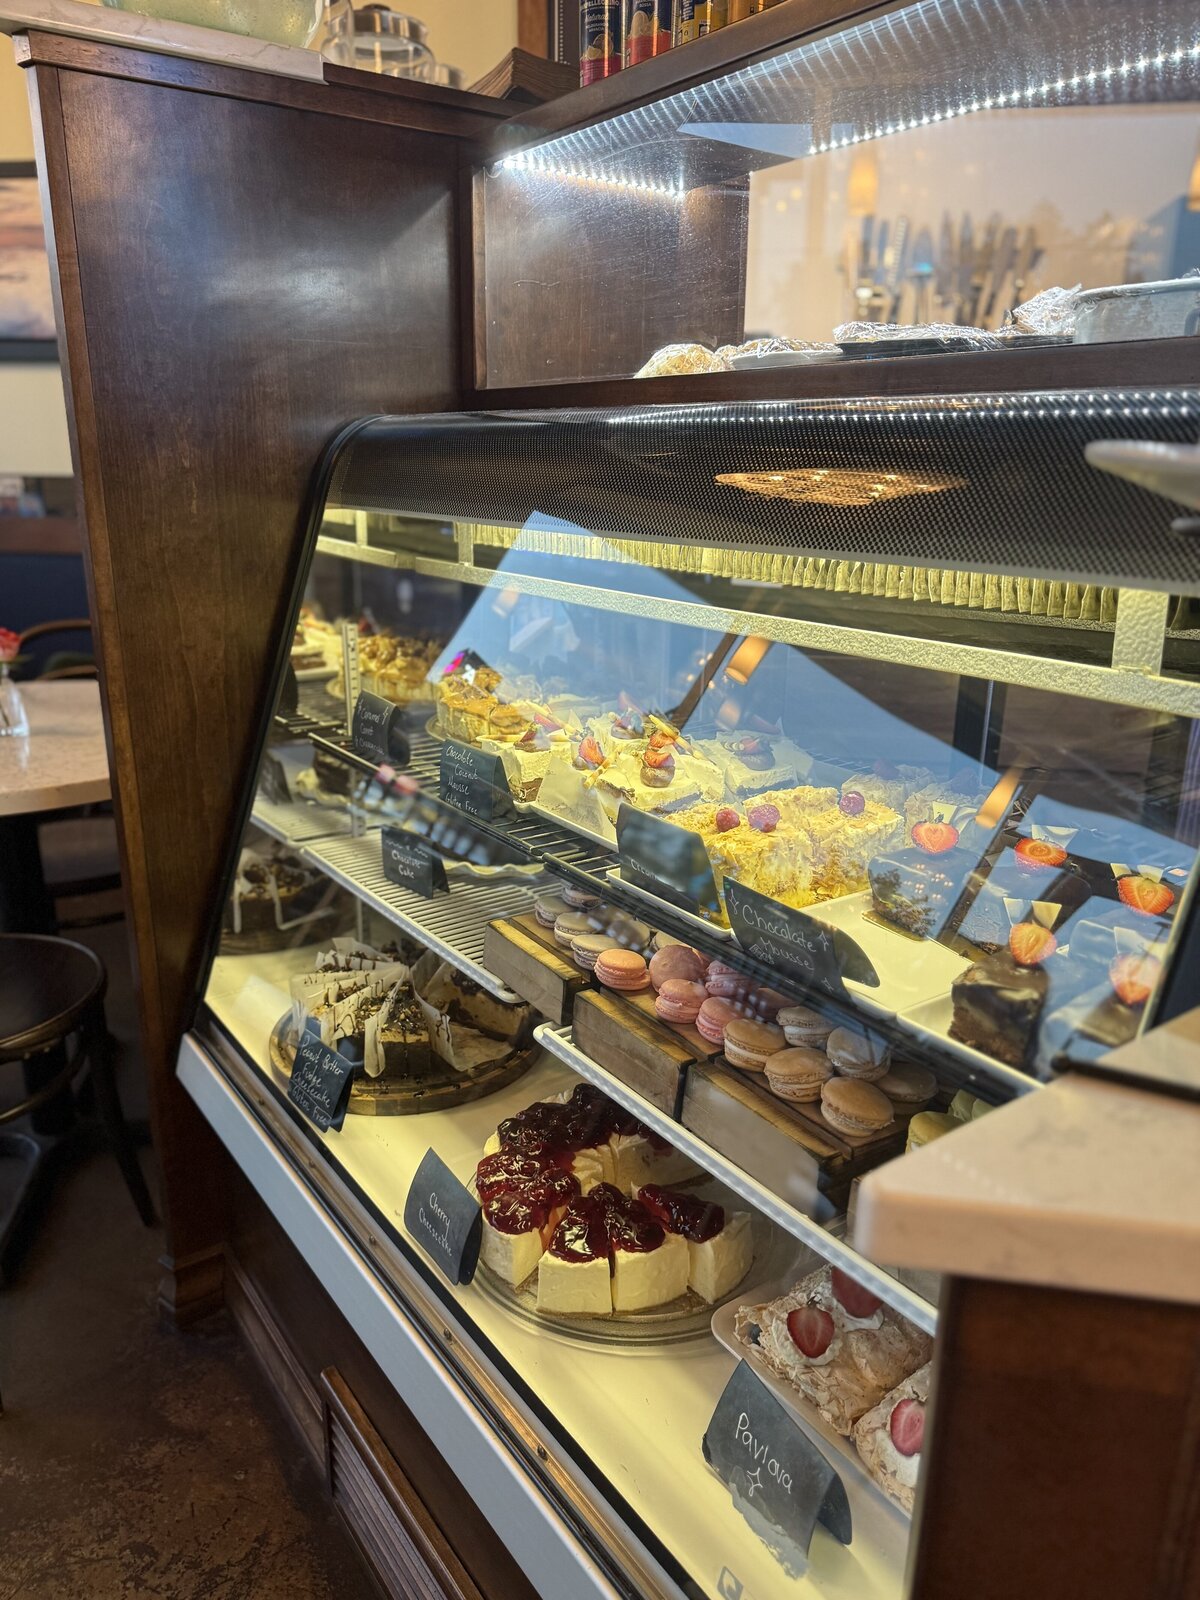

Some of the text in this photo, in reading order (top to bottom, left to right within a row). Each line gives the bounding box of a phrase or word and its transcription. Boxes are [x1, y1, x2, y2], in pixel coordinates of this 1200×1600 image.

[445, 745, 474, 767] Chocolate
[447, 775, 470, 795] Mousse
[445, 792, 478, 815] Gluten Free
[391, 850, 421, 869] Chocolate
[398, 864, 415, 879] Cake
[742, 904, 817, 953] Chocolate
[759, 936, 815, 971] Mousse
[299, 1034, 344, 1076] Peanut Butter
[302, 1062, 322, 1087] Fudge
[293, 1071, 331, 1107] Cheesecake
[312, 1105, 333, 1126] Free
[429, 1192, 451, 1241] Cherry
[735, 1412, 793, 1495] Pavlova
